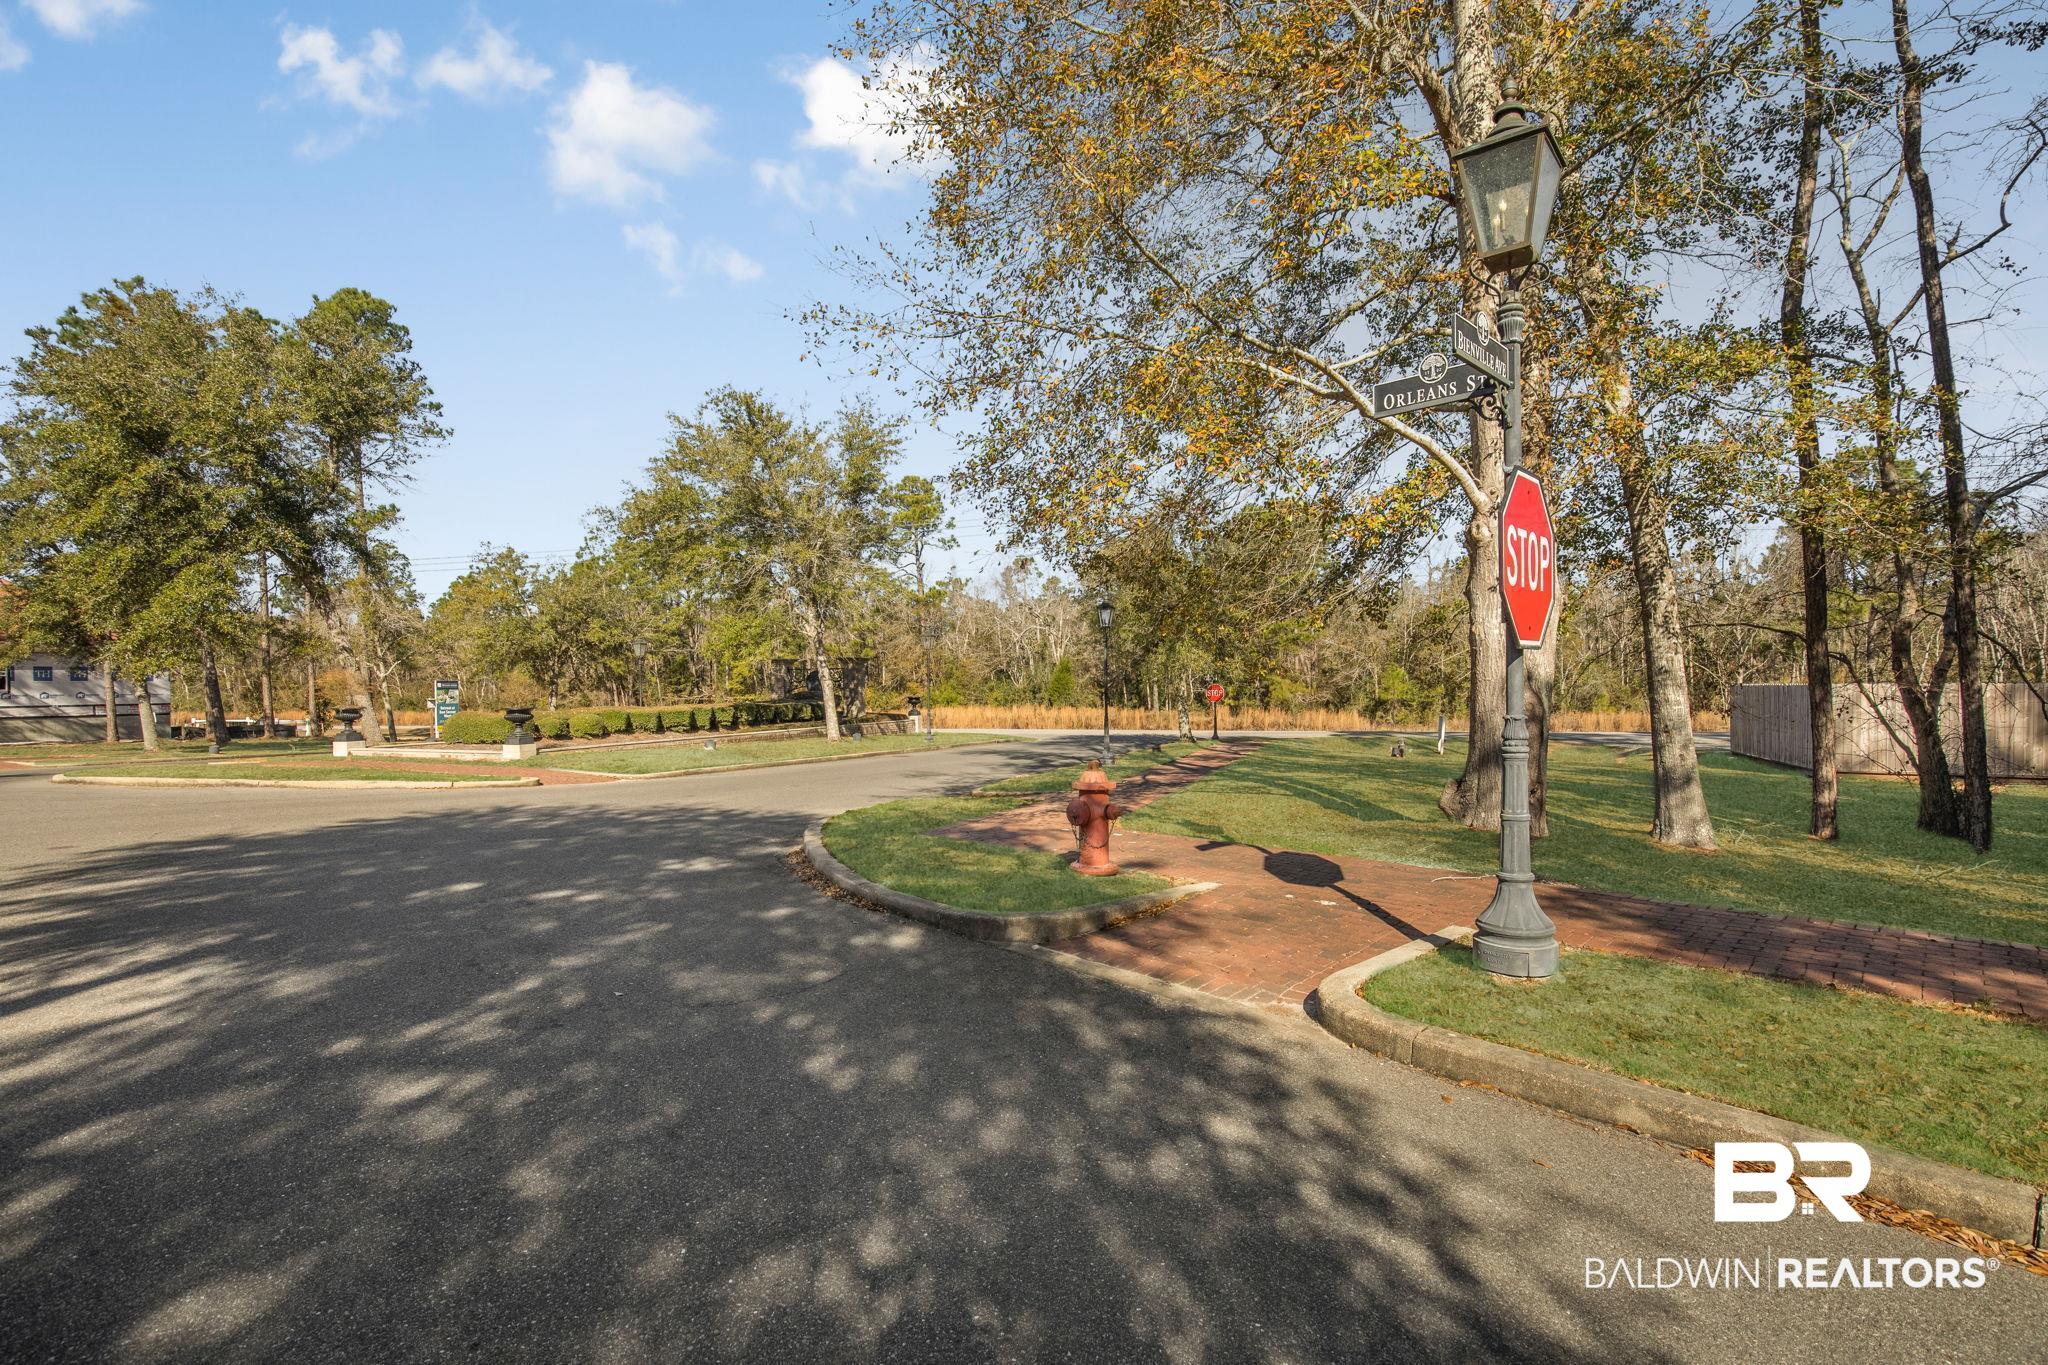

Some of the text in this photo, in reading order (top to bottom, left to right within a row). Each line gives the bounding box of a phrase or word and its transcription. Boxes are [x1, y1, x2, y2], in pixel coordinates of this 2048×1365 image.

[1457, 330, 1507, 378] BIENVILLE AVE
[1383, 374, 1488, 410] ORLEANS ST
[1506, 524, 1550, 592] STOP
[1207, 689, 1223, 697] STOP
